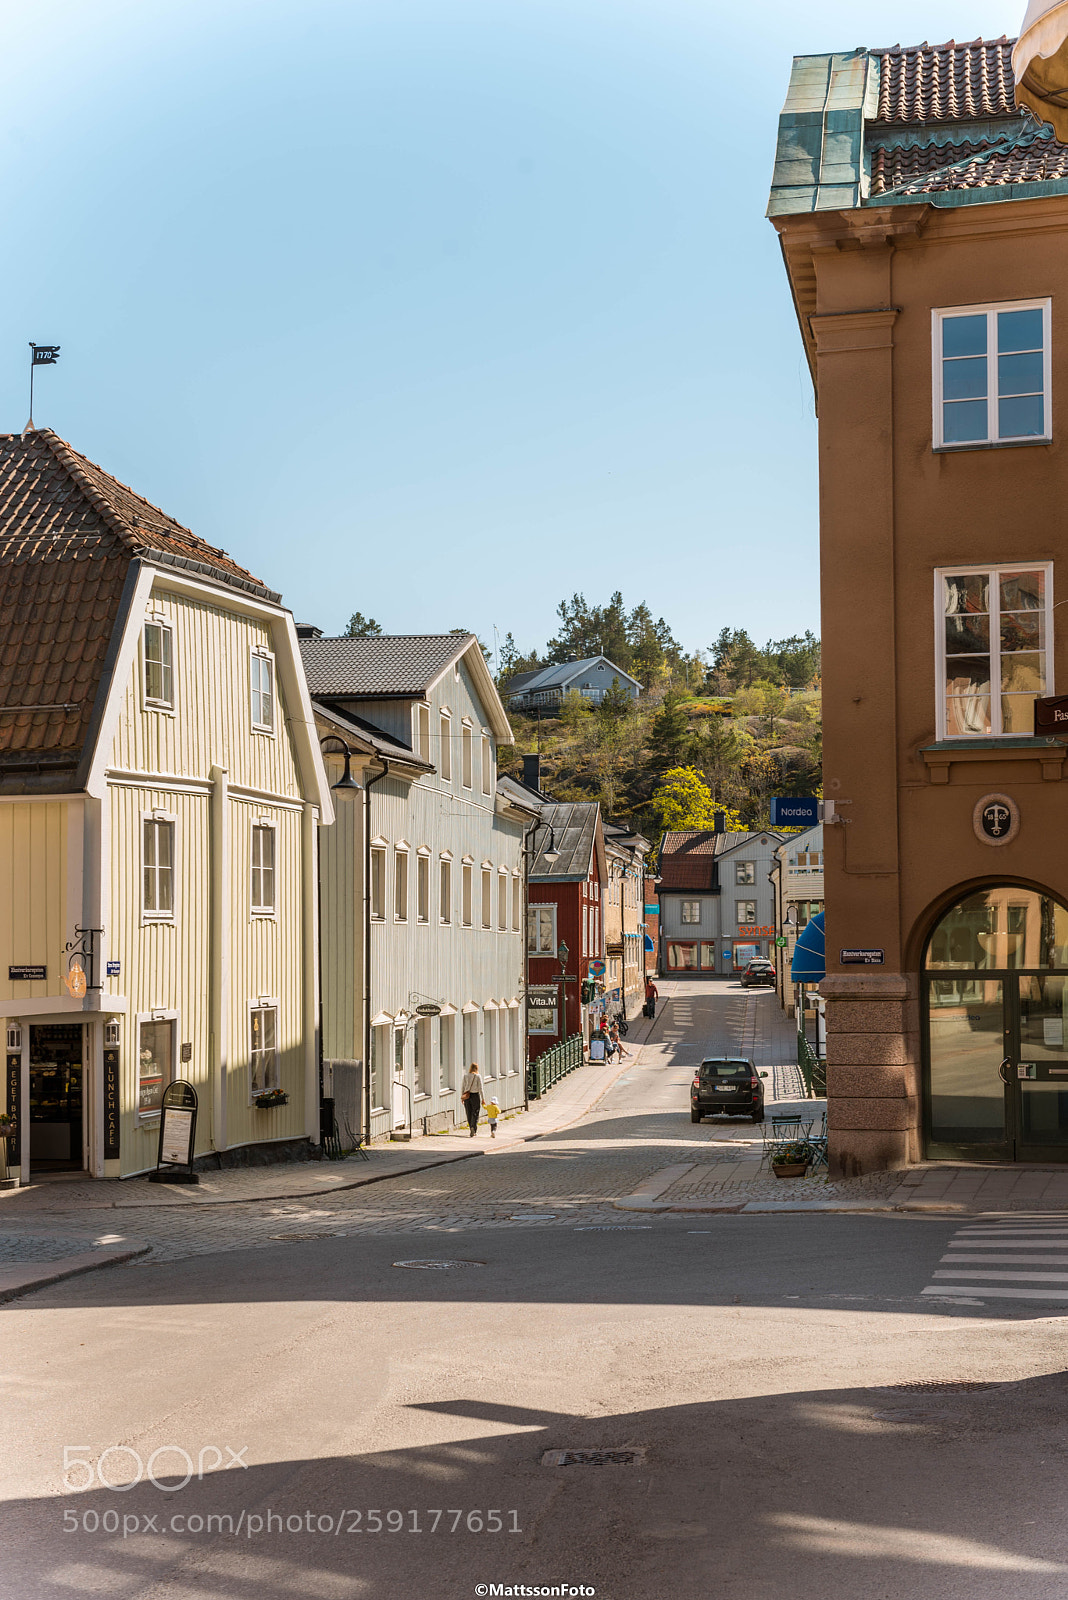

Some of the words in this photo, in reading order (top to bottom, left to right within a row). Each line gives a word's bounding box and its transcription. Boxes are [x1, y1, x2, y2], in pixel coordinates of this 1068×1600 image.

[36, 351, 52, 359] 1770
[781, 807, 813, 816] Nordea
[530, 997, 556, 1006] Vita.M
[107, 1066, 115, 1109] LUNCH
